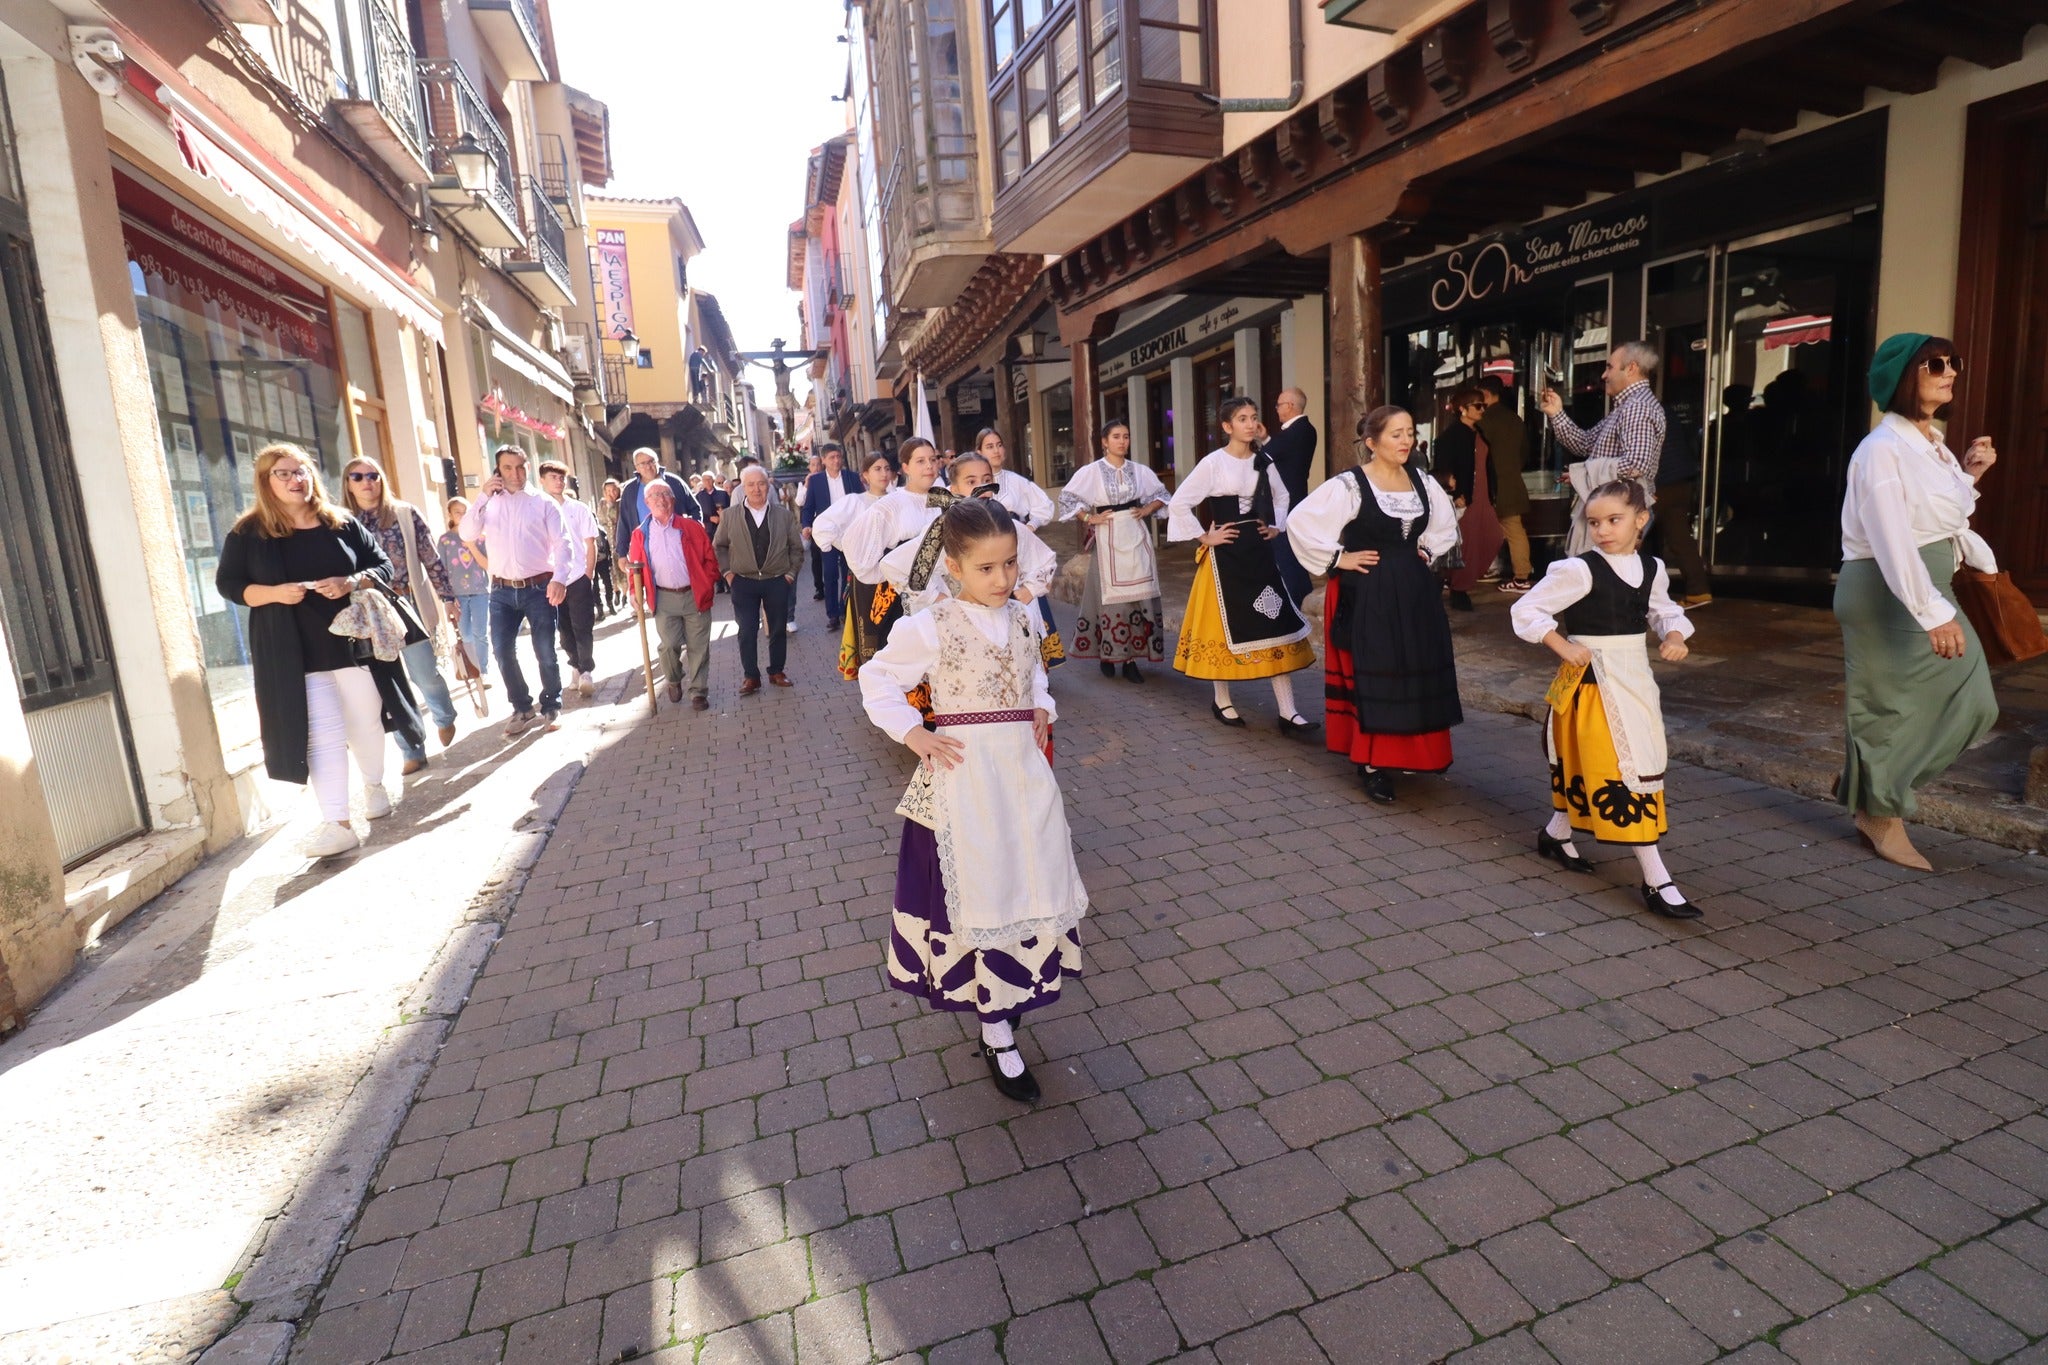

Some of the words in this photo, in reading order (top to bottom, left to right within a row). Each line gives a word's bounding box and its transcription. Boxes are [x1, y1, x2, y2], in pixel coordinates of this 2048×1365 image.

[171, 208, 277, 287] decastro&manrique
[597, 230, 625, 244] PAN
[604, 251, 622, 268] LA
[1525, 236, 1562, 264] San
[1568, 214, 1648, 252] Marcos
[608, 269, 628, 334] ESPIGA
[1130, 349, 1140, 367] EL
[1140, 327, 1189, 362] SOPORTAL
